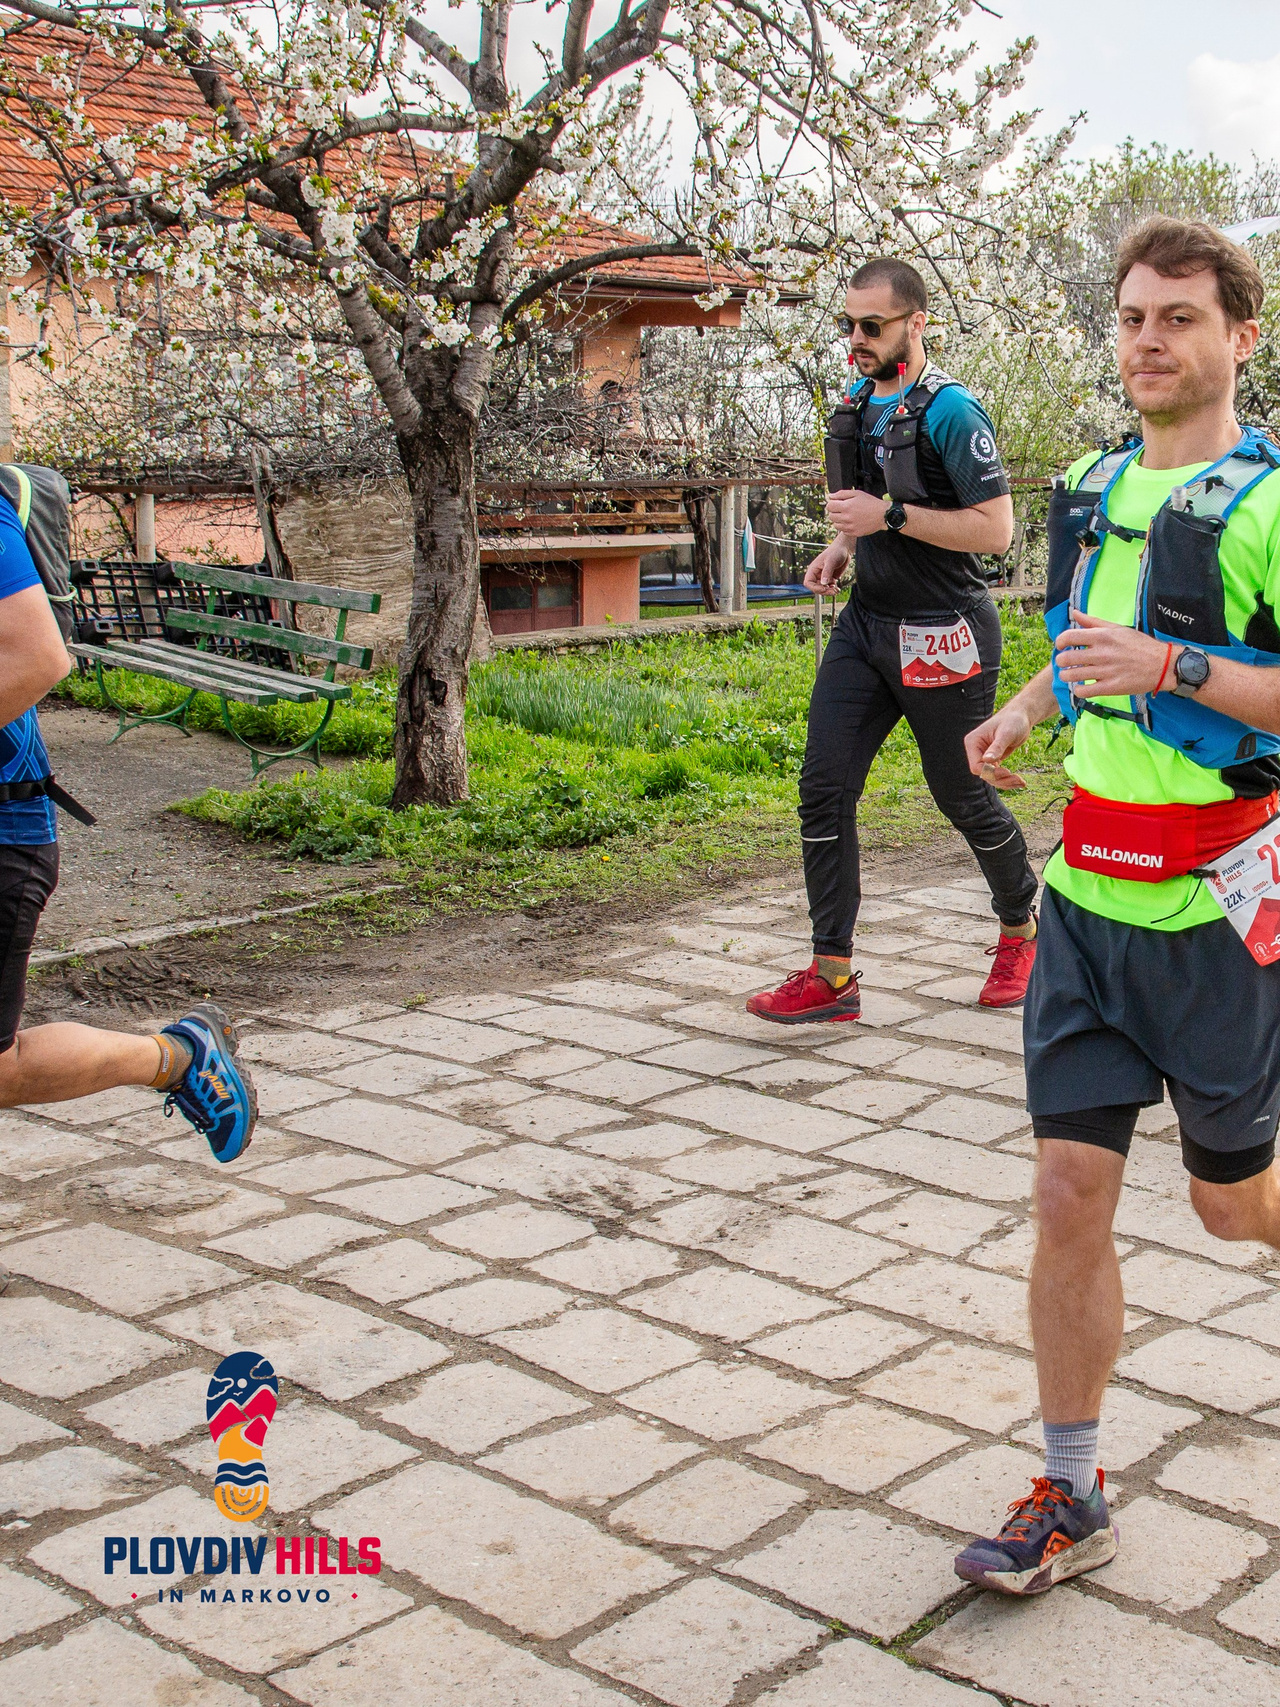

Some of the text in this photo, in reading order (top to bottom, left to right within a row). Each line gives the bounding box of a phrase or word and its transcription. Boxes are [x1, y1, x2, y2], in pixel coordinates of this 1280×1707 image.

[924, 625, 972, 656] 2403
[1080, 843, 1164, 869] SALOMON
[1221, 858, 1246, 878] PLOVDIV
[1225, 869, 1243, 884] HILLS
[1223, 889, 1247, 910] 22K
